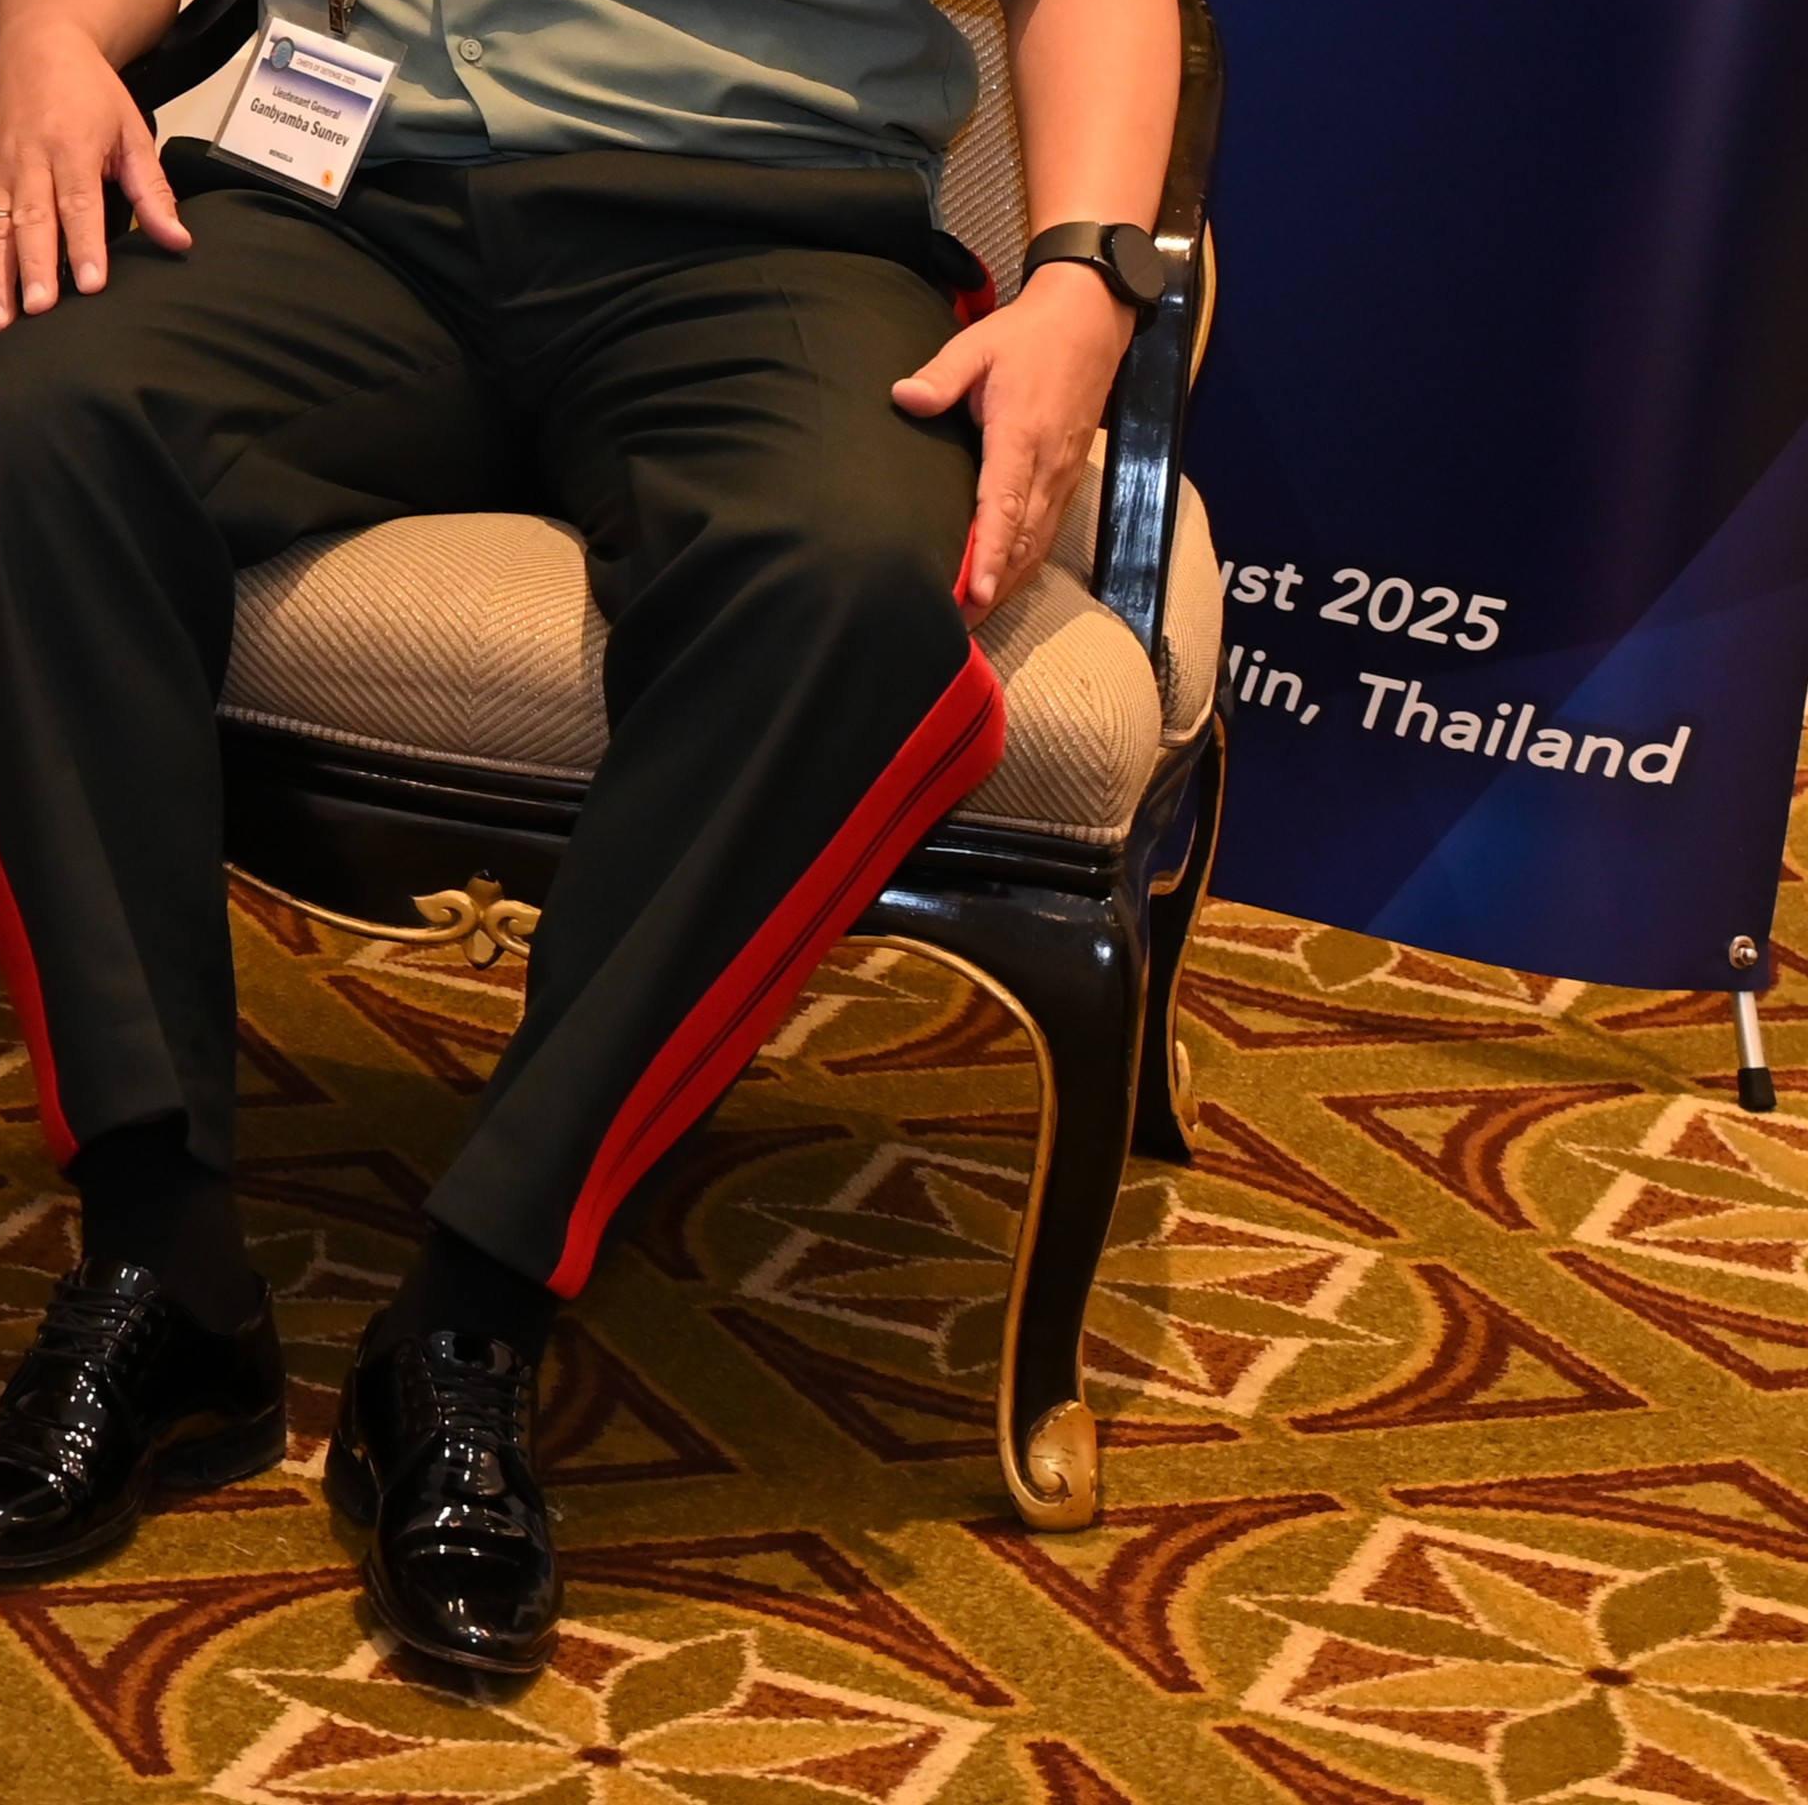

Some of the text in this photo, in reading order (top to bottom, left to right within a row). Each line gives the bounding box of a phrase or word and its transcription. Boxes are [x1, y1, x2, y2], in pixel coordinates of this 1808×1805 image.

[250, 97, 350, 147] Ganbyamba Sunrev
[272, 85, 342, 120] Lieutenant General
[1319, 568, 1507, 651] 2025
[1359, 672, 1691, 785] Thailand
